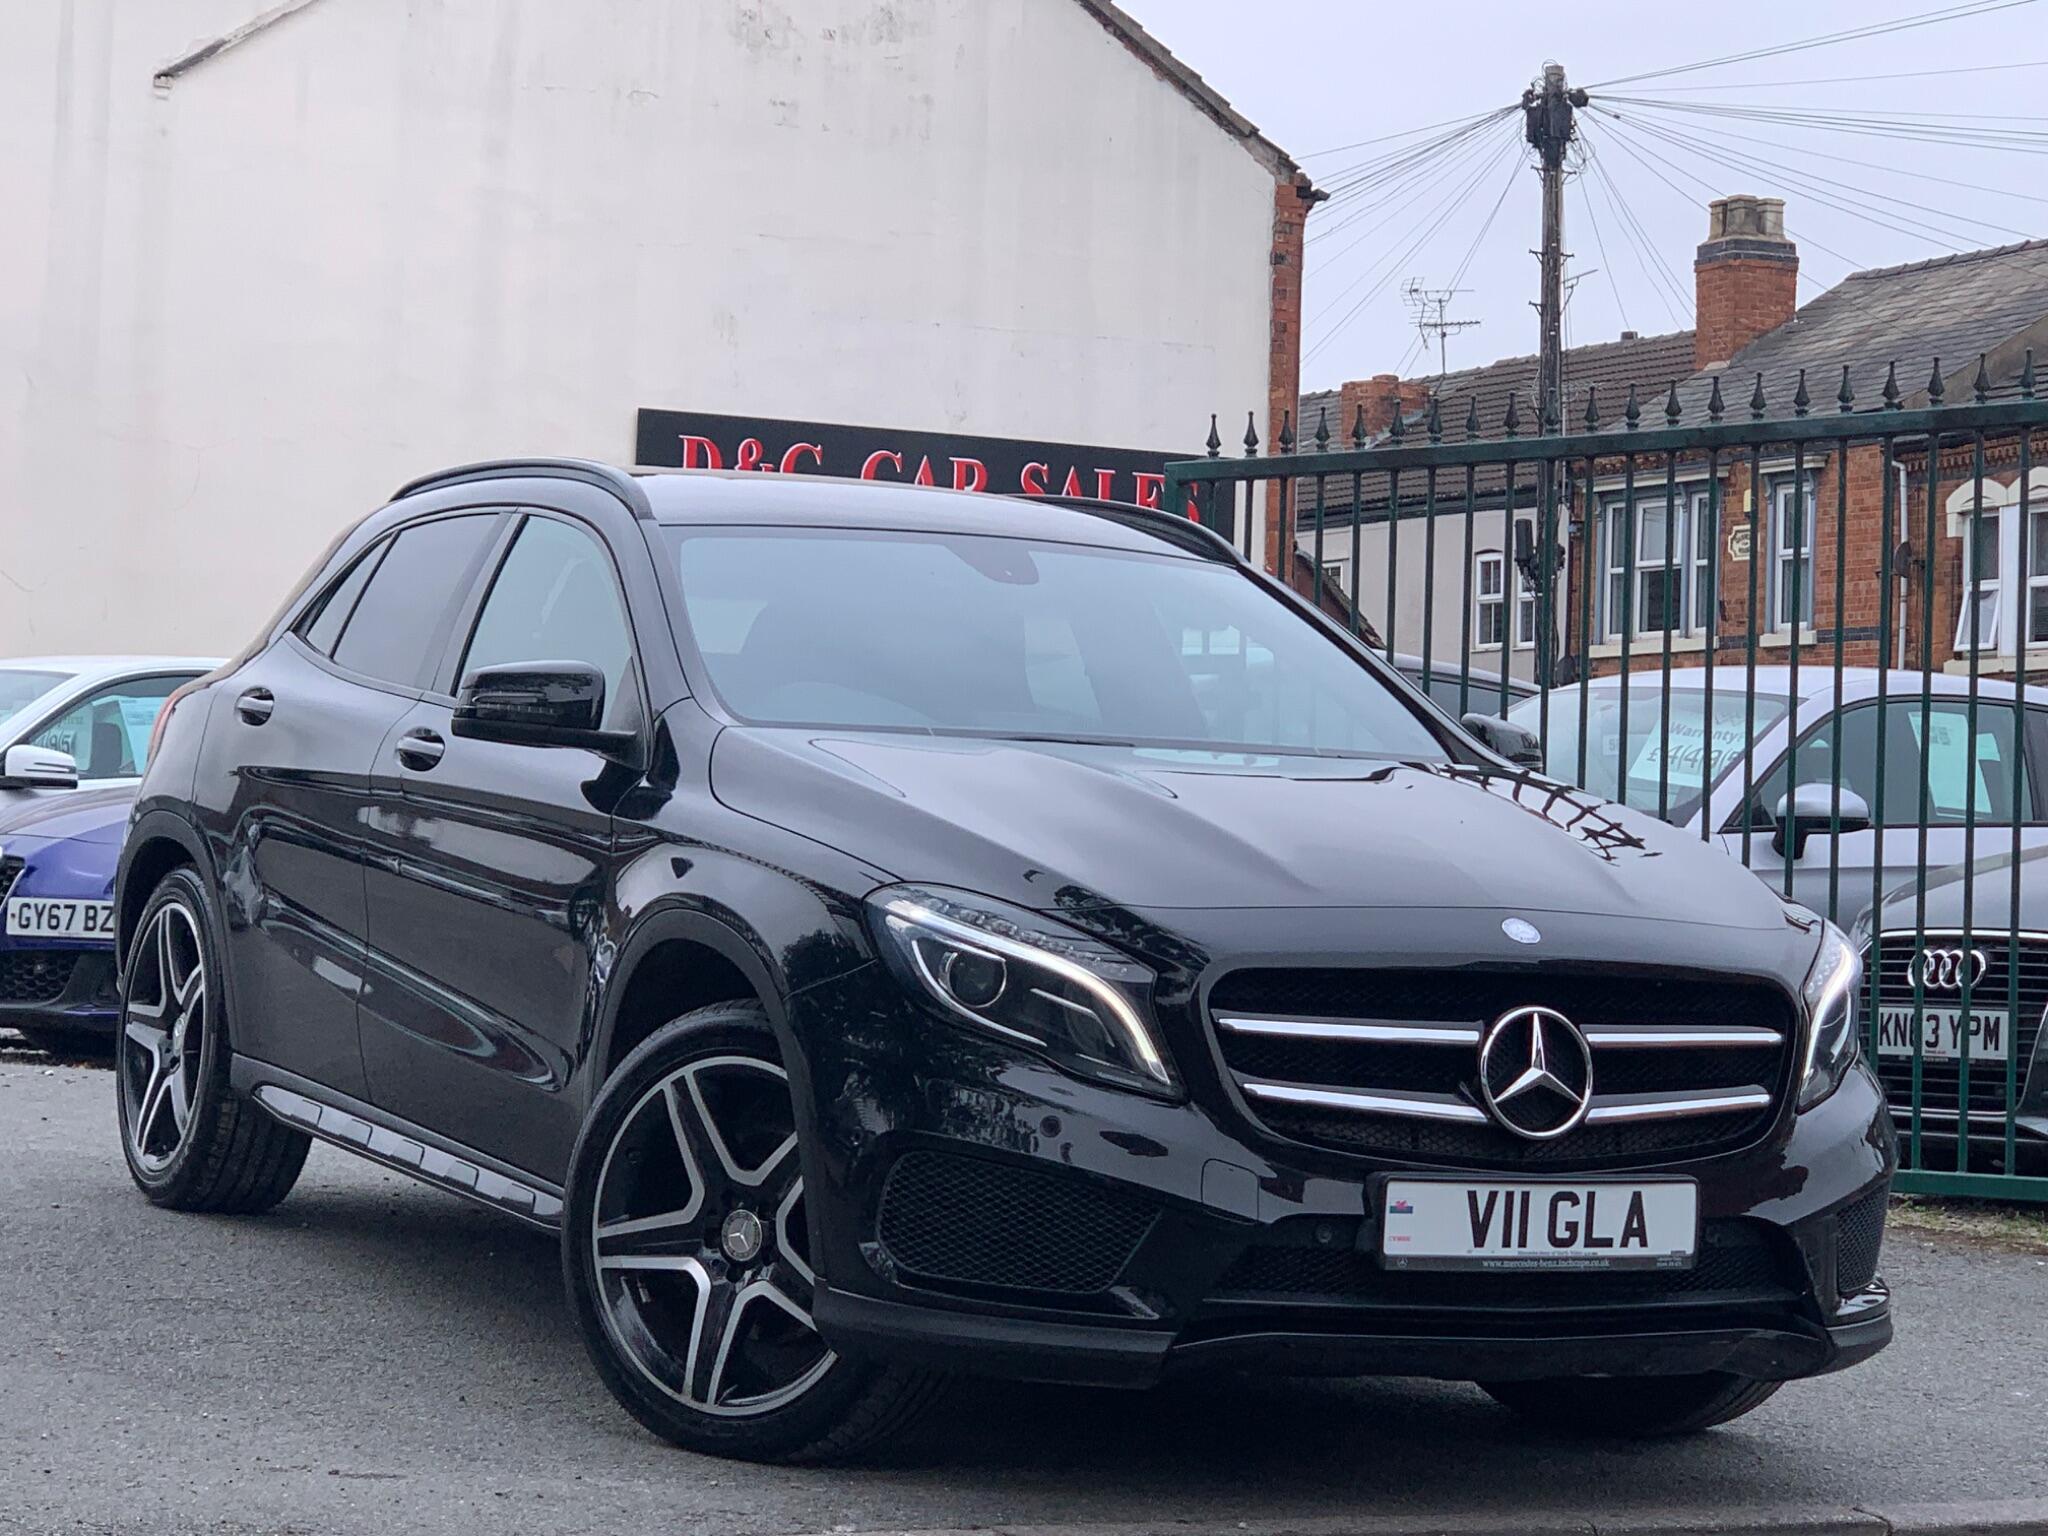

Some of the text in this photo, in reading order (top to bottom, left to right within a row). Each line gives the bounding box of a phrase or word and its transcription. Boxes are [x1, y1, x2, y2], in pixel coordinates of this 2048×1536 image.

[18, 902, 115, 932] GY67 BZ
[1949, 1014, 2001, 1052] YPM
[1547, 1190, 1649, 1249] GLA
